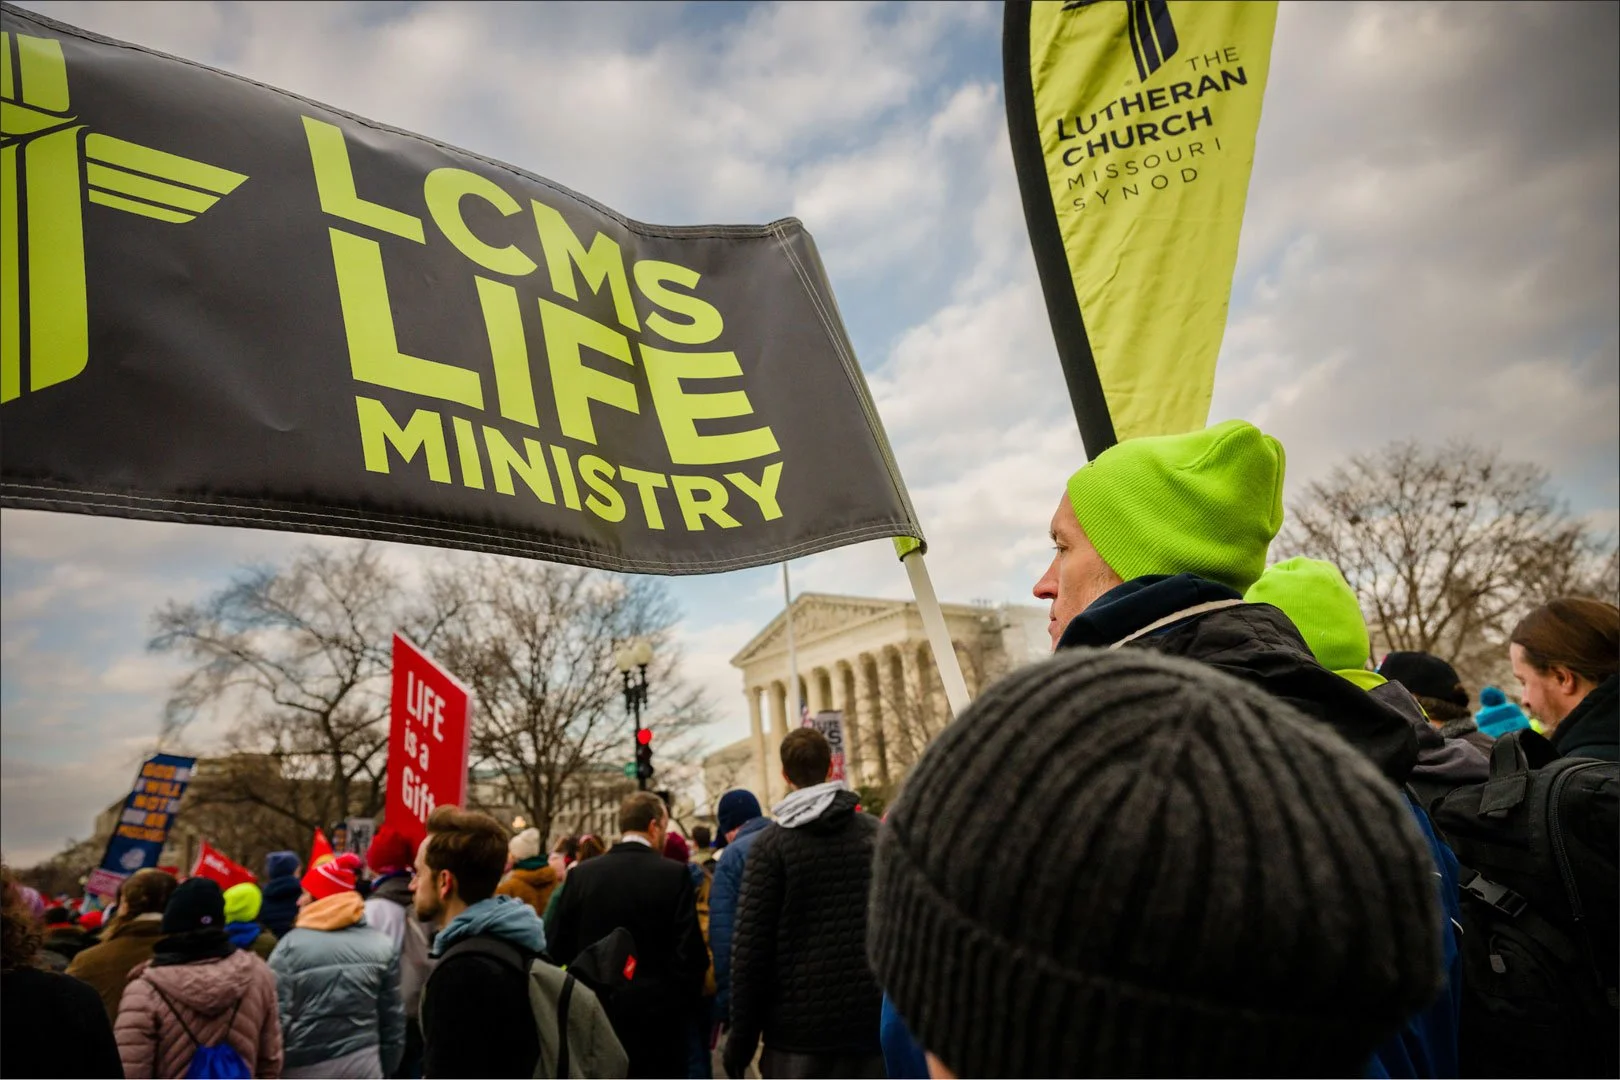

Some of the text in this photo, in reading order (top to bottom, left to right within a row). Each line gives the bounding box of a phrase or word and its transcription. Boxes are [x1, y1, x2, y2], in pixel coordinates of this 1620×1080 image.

[1186, 47, 1239, 71] THE
[1057, 66, 1248, 142] LUTHERAN
[1062, 106, 1213, 166] CHURCH
[1067, 137, 1221, 190] MISSOURI
[1073, 167, 1198, 212] SYNOD
[301, 115, 724, 344] LCMS
[329, 227, 781, 465] LIFE
[355, 395, 784, 531] MINISTRY
[406, 670, 446, 742] LIFE
[404, 719, 430, 772] is a
